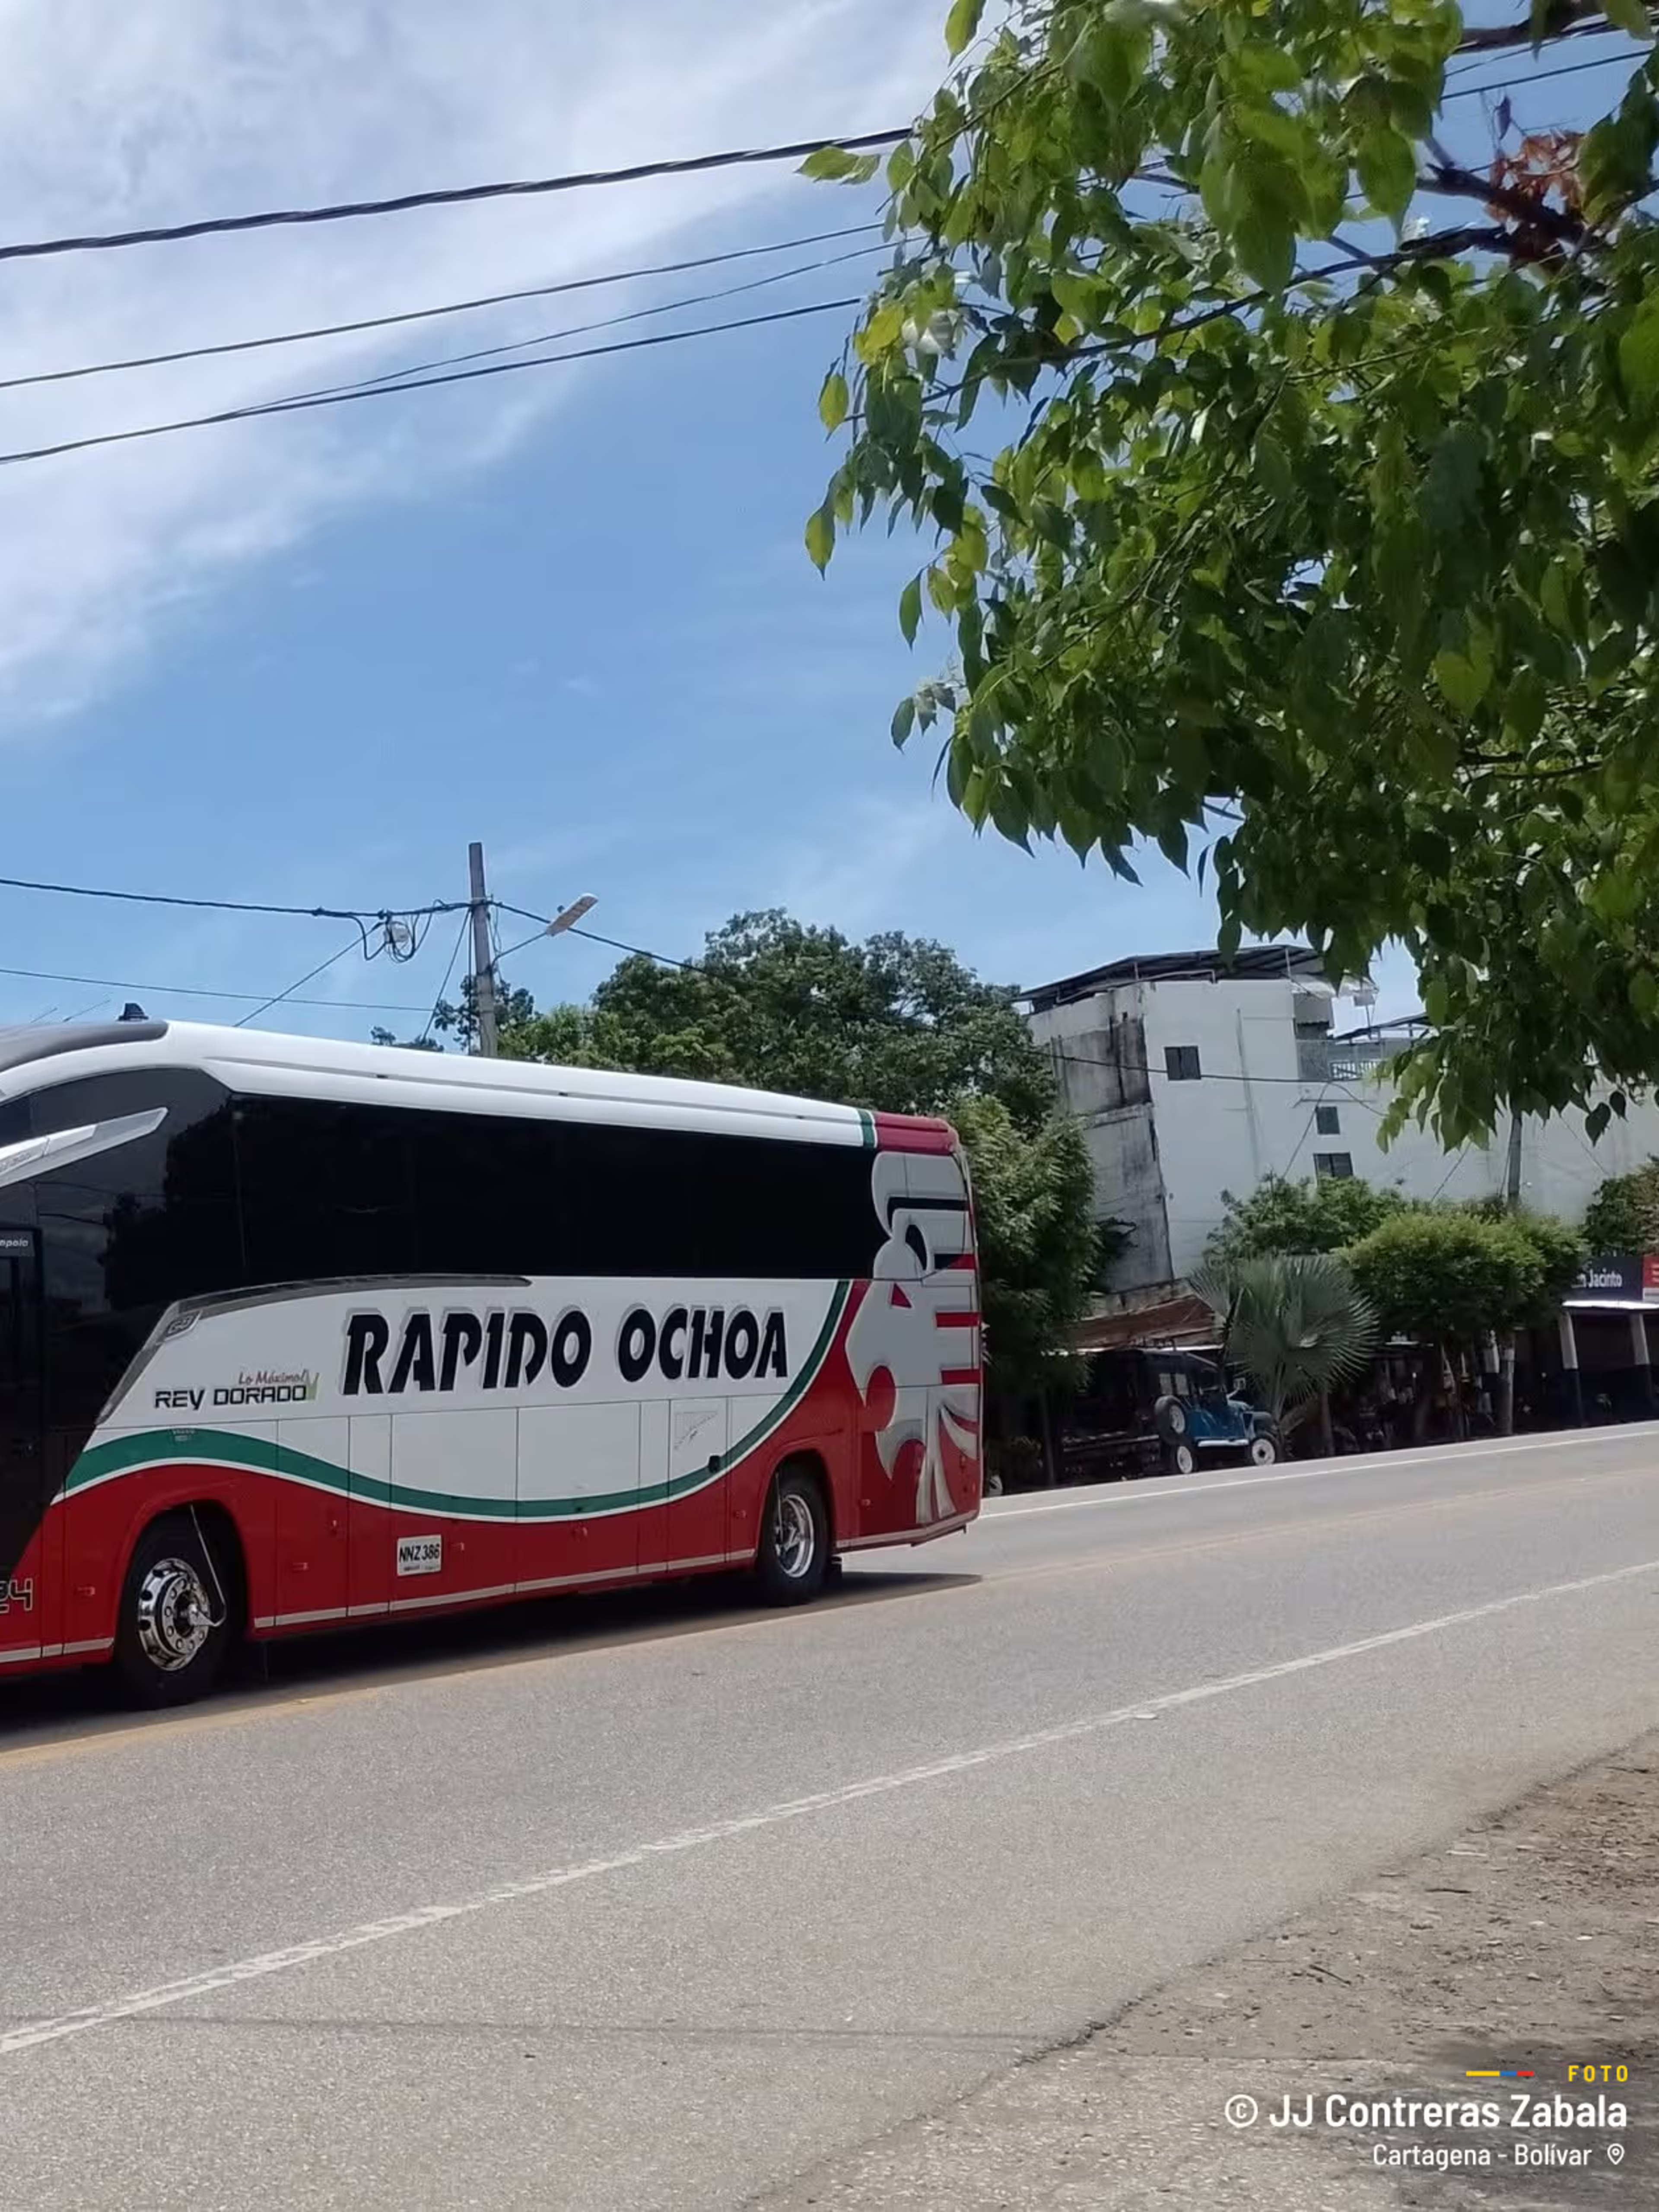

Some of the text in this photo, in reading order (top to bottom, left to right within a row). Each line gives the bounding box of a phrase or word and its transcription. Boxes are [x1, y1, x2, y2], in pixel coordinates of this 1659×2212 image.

[1588, 1268, 1622, 1288] Jacinto
[343, 1305, 788, 1395] RAPIDO OCHOA
[155, 1385, 307, 1411] REY DORADO
